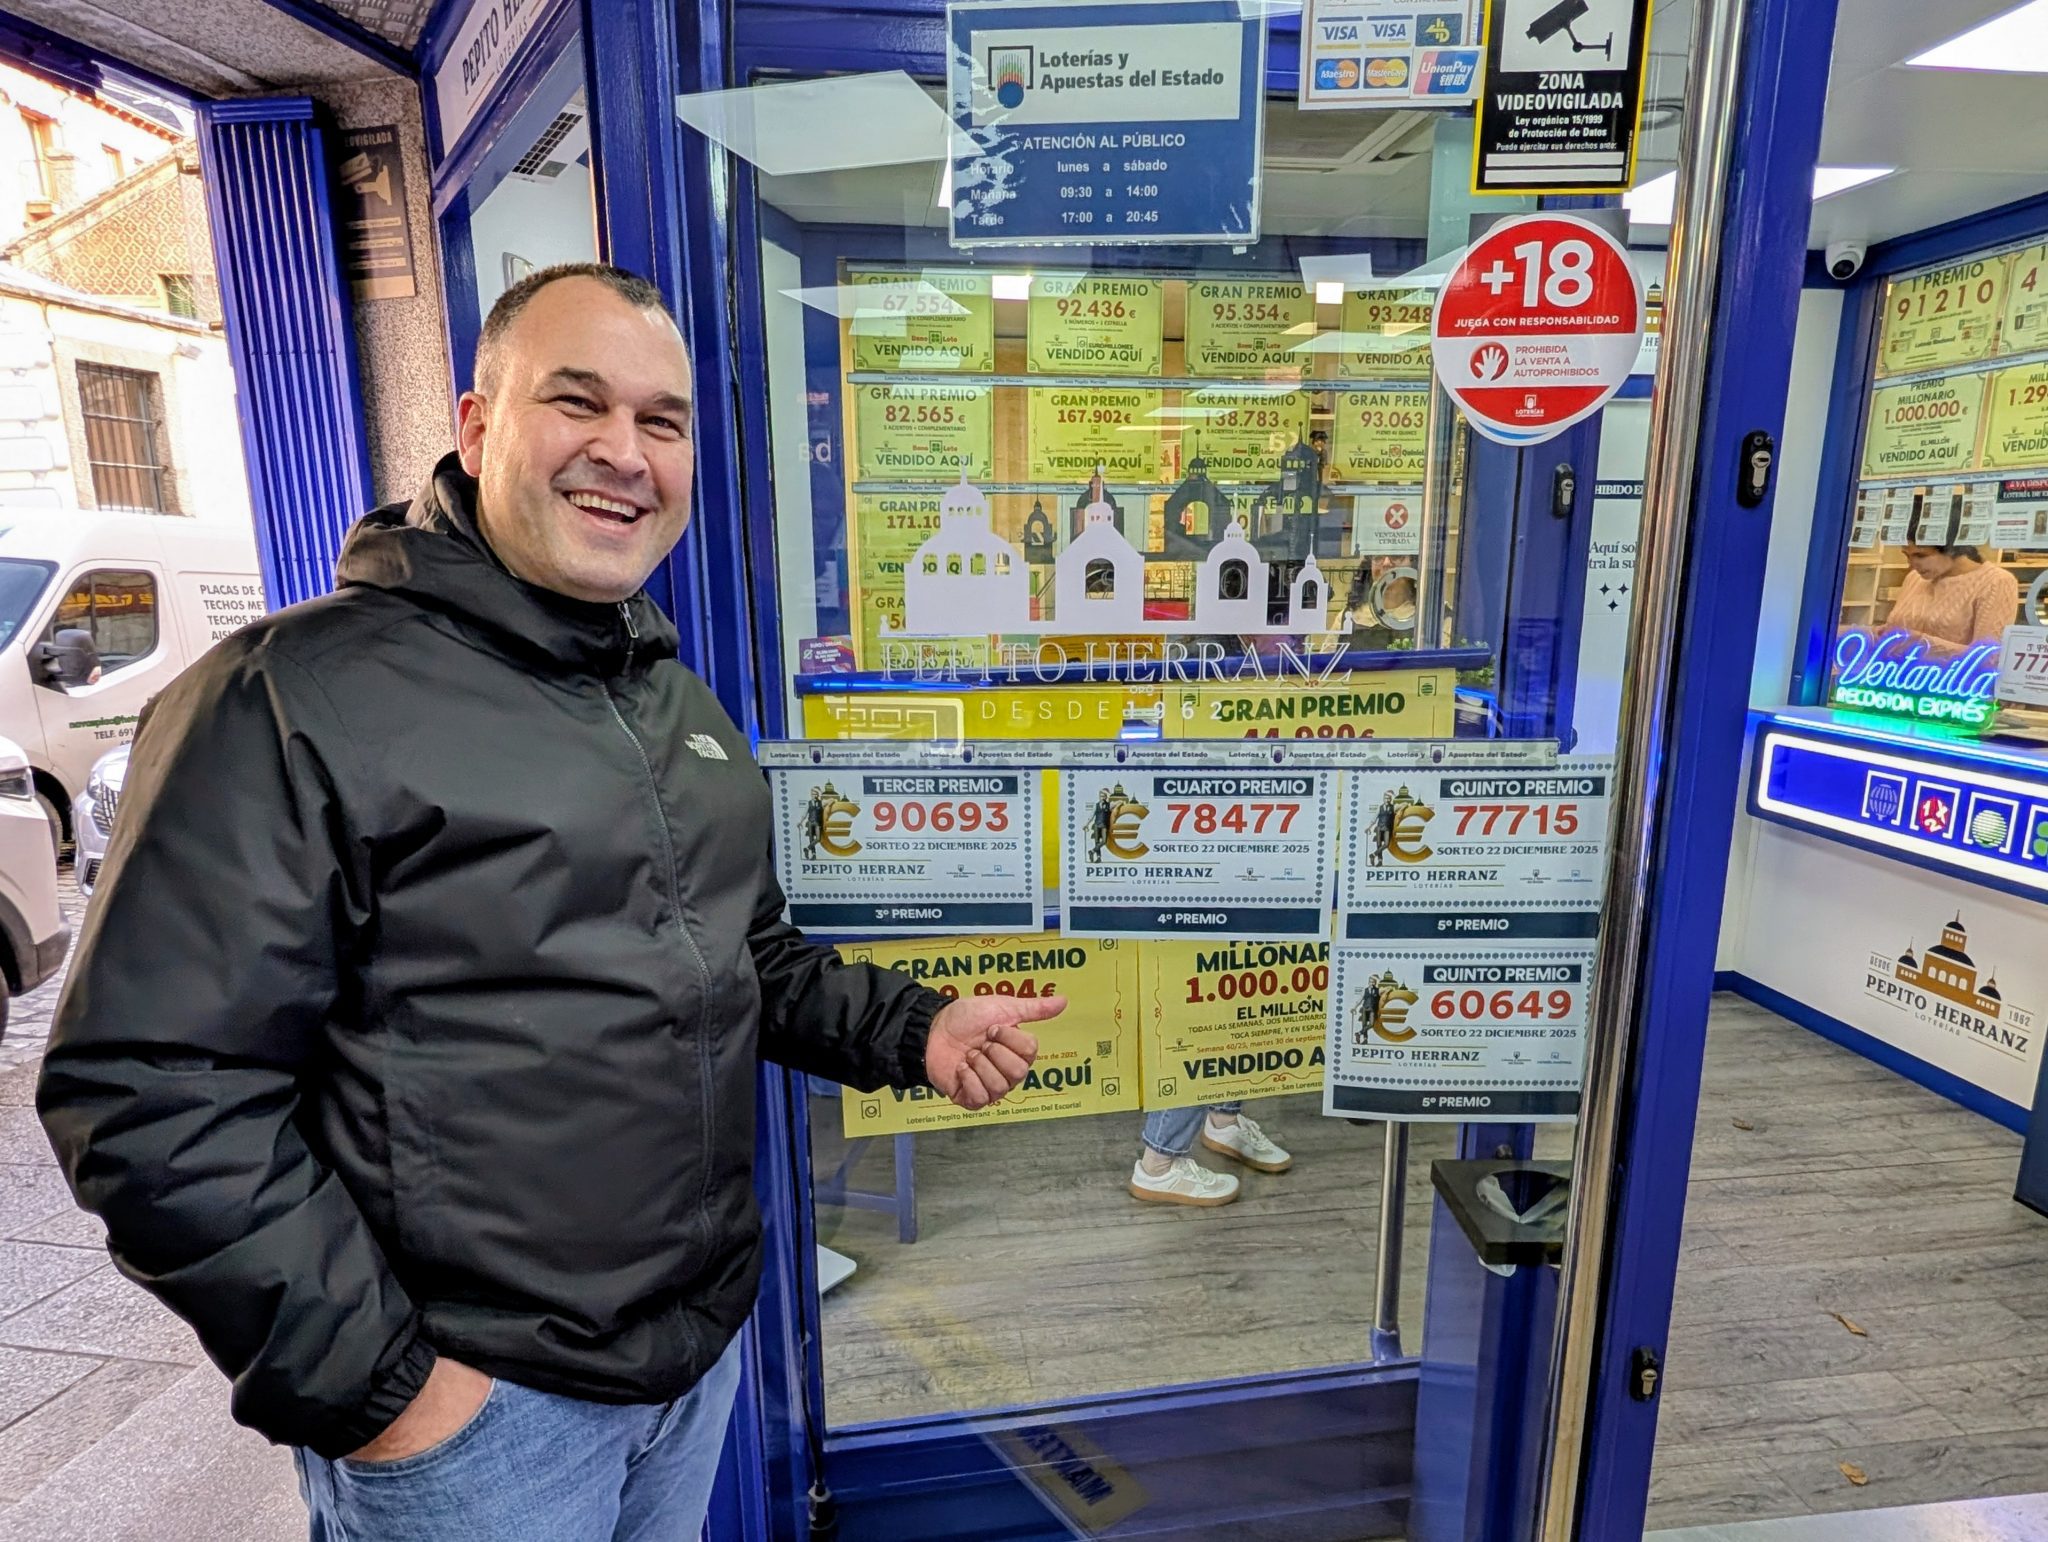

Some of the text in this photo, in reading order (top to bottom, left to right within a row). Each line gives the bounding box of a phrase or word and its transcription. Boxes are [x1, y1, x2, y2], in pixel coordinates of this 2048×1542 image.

[1322, 26, 1358, 40] VISA
[1371, 24, 1406, 37] VISA
[1040, 50, 1129, 68] Loterías y
[1421, 61, 1473, 76] UnionPay
[1040, 69, 1224, 93] Apuestas del Estado
[1538, 73, 1585, 90] ZONA
[1497, 92, 1623, 110] VIDEOVIGILADA
[1516, 114, 1603, 126] Ley orgánica 15/1999
[1509, 127, 1607, 138] de Protección de Datos
[1023, 131, 1185, 150] ATENCIÓN AL PÚBLICO
[1496, 143, 1517, 151] Puede
[1519, 142, 1549, 152] ejercitar
[1551, 143, 1563, 151] sus
[1565, 142, 1598, 150] derechos
[1057, 161, 1089, 173] lunes
[1103, 163, 1110, 172] a
[1124, 159, 1167, 172] sábado
[1060, 186, 1092, 198] 09:30
[1105, 188, 1112, 198] a
[1126, 185, 1158, 197] 14:00
[1061, 211, 1093, 224] 17:00
[1106, 213, 1113, 223] a
[1126, 211, 1158, 223] 20:45
[1480, 238, 1594, 308] +18
[1923, 262, 1984, 290] PREMIO
[1043, 281, 1149, 296] GRAN PREMIO
[1200, 285, 1302, 299] GRAN PREMIO
[1897, 279, 1994, 321] 91210
[1057, 299, 1125, 318] 92.436
[1213, 303, 1279, 321] 95.354
[1454, 315, 1619, 328] JUEGA CON RESPONSABILIDAD
[1046, 348, 1143, 362] VENDIDO AQUÍ
[1515, 345, 1568, 354] PROHIBIDA
[1357, 353, 1412, 365] VENDIDO
[1514, 356, 1570, 366] LA VENTA A
[1513, 367, 1600, 378] AUTOPROHIBIDOS
[1050, 395, 1141, 407] GRAN PREMIO
[1897, 389, 1956, 406] MILLONARIO
[885, 404, 954, 424] 82.565
[1058, 409, 1132, 424] 167.902 €
[1361, 410, 1424, 428] 93.063
[1885, 399, 1968, 424] 1.000.000 €
[1349, 457, 1404, 469] VENDIDO
[1589, 541, 1620, 556] Aquí
[200, 584, 255, 595] PLACAS DE
[203, 600, 245, 610] TECHOS
[207, 615, 248, 625] TECHOS
[878, 641, 1068, 683] PEPITO
[1083, 641, 1353, 683] HERRANZ
[1835, 632, 2000, 699] Ventanilla
[981, 700, 1223, 721] DESDE 1962
[1836, 686, 1990, 722] RECOGIDA EXPRÉS
[94, 729, 116, 740] TELF.
[1072, 751, 1103, 759] Loterías
[1131, 751, 1165, 760] Apuestas
[1166, 750, 1178, 758] del
[1179, 750, 1208, 758] Estado
[871, 779, 1003, 793] TERCER PREMIO
[1163, 779, 1306, 795] CUARTO PREMIO
[1450, 779, 1593, 796] QUINTO PREMIO
[873, 801, 1009, 832] 90693
[1167, 803, 1300, 834] 78477
[1453, 804, 1578, 836] 77715
[866, 841, 1017, 850] SORTEO 22 DICIEMBRE 2025
[1153, 844, 1310, 853] SORTEO 22 DICIEMBRE 2025
[1437, 845, 1598, 855] SORTEO 22 DICIEMBRE 2025
[802, 864, 925, 875] PEPITO HERRANZ
[1086, 867, 1213, 877] PEPITO HERRANZ
[875, 908, 943, 919] 3º PREMIO
[1157, 913, 1227, 924] 4º PREMIO
[1437, 919, 1509, 930] 5º PREMIO
[1869, 955, 1891, 972] DESDE
[1433, 966, 1571, 982] QUINTO PREMIO
[1186, 964, 1329, 1004] 1.000.00
[1237, 995, 1323, 1020] EL MILLÓN
[1430, 989, 1572, 1020] 60649
[1865, 974, 2030, 1054] PEPITO HERRANZ
[1188, 1025, 1213, 1034] TODAS
[1214, 1023, 1227, 1031] LAS
[1228, 1019, 1265, 1030] SEMANAS,
[1266, 1018, 1281, 1026] DOS
[1230, 1031, 1249, 1040] TOCA
[1251, 1028, 1283, 1038] SIEMPRE,
[1352, 1048, 1480, 1062] PEPITO HERRANZ
[1422, 1096, 1491, 1108] 5º PREMIO
[906, 1101, 1082, 1125] Loterías Pepito Herranz San Lorenzo Del Escorial
